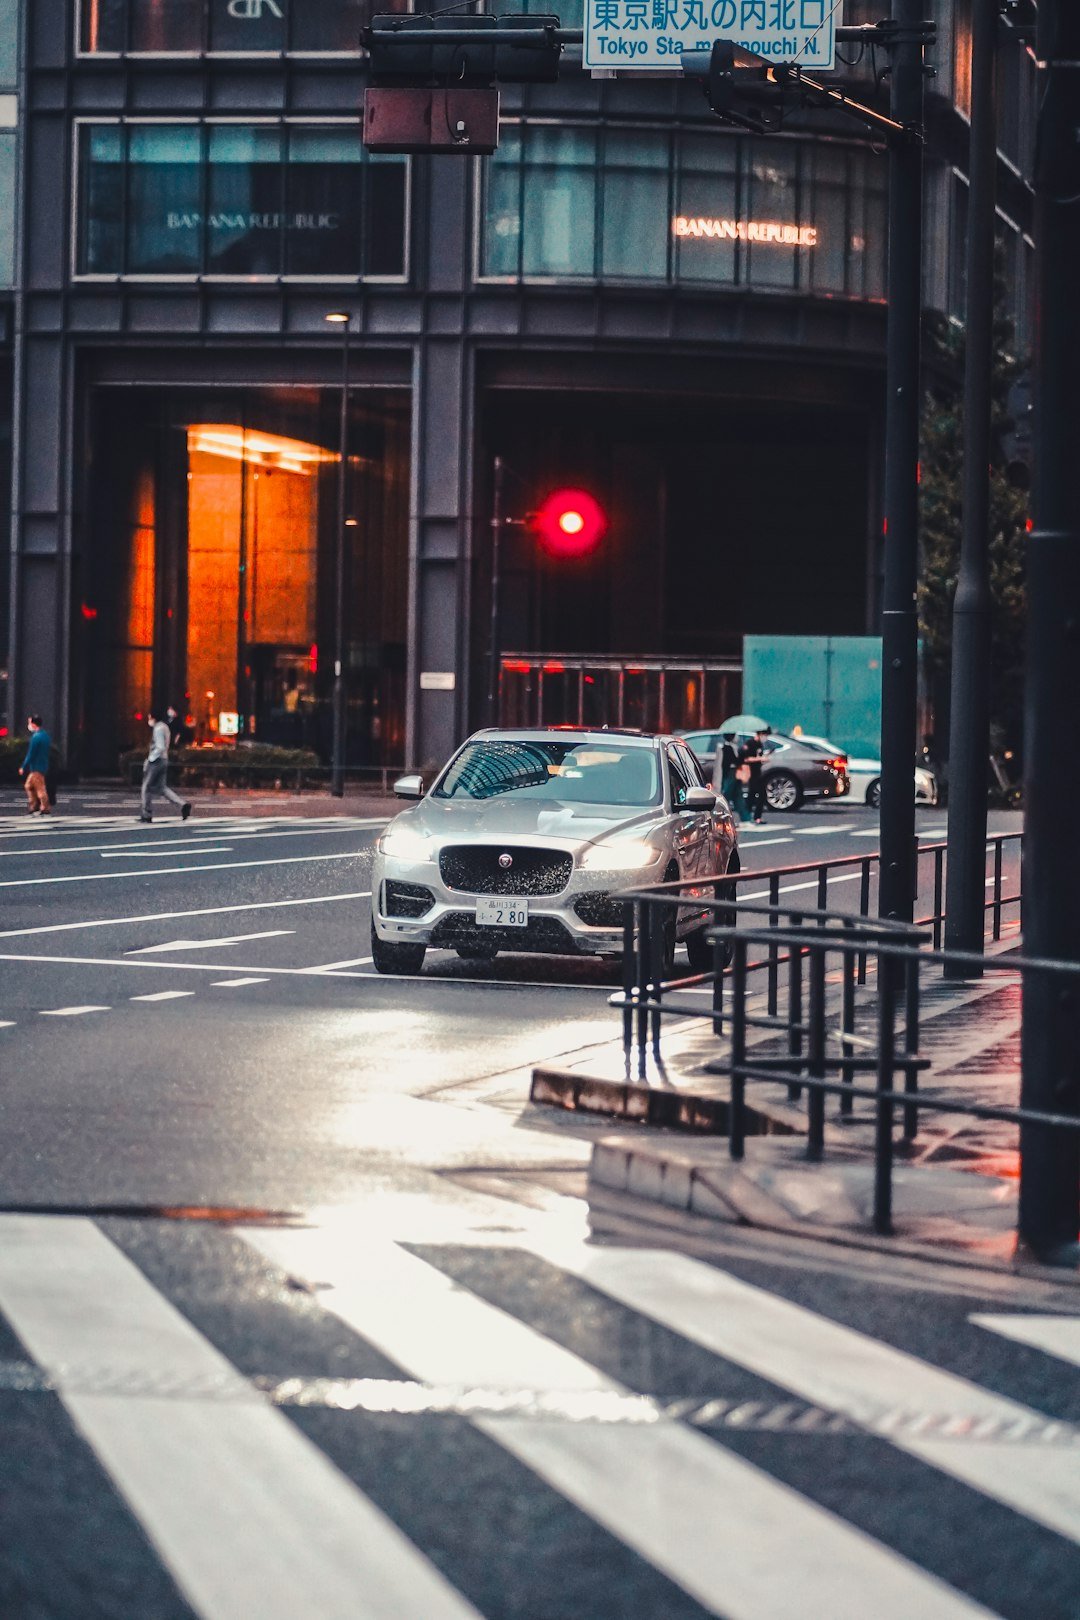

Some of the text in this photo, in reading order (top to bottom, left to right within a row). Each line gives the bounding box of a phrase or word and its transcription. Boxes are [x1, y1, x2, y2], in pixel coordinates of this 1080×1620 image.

[592, 0, 824, 31] 東京駅丸の内北口
[597, 36, 648, 58] Tokyo
[696, 37, 797, 55] mnouchi
[804, 37, 821, 55] N.
[747, 222, 817, 246] REPUBLIC
